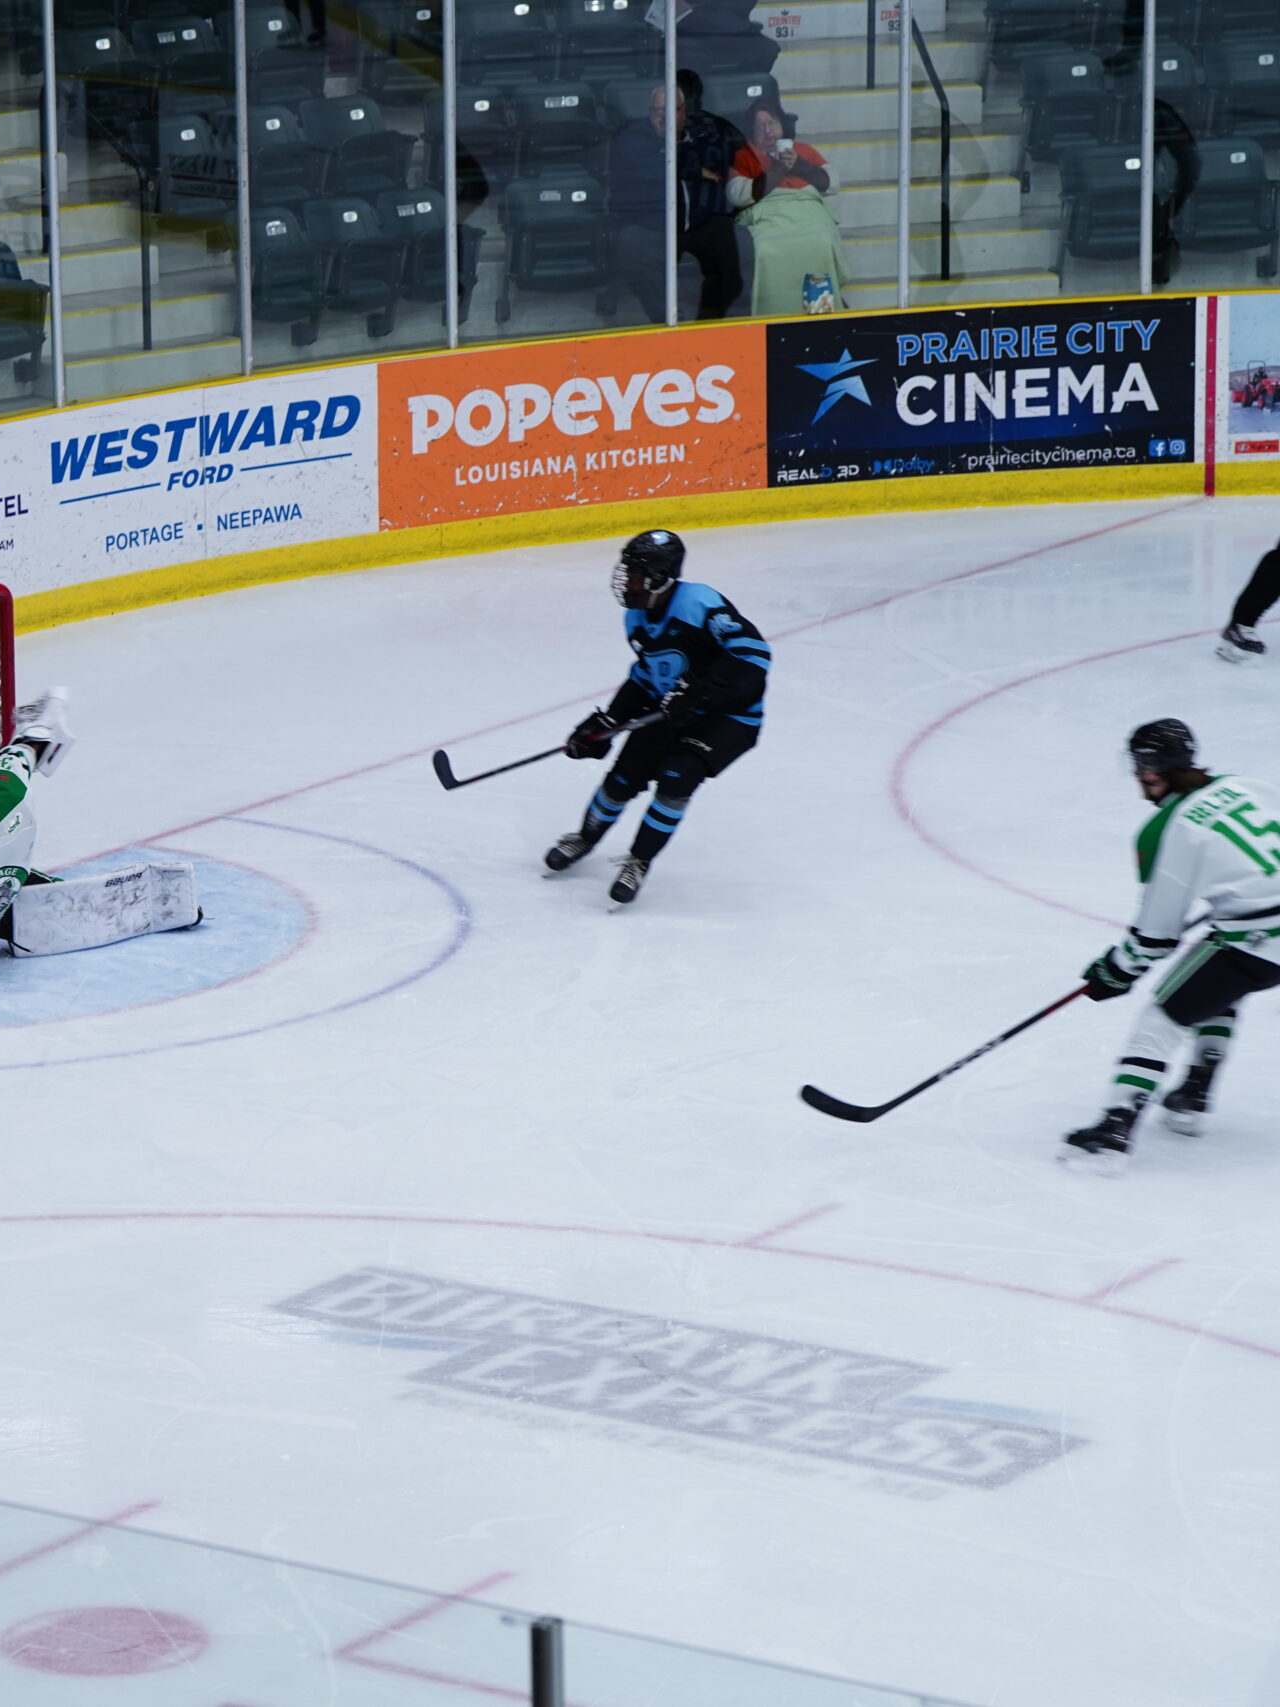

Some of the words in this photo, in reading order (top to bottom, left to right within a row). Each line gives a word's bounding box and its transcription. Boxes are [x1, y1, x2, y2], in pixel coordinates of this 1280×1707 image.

[768, 16, 802, 28] COUNTRY
[896, 324, 1058, 367] PRAIRIE
[1066, 319, 1161, 355] CITY
[895, 362, 1159, 427] CINEMA
[50, 394, 361, 485] WESTWARD
[967, 446, 1136, 471] prairiecitycinema.ca
[166, 463, 234, 492] FORD
[455, 454, 577, 487] LOUISIANA
[585, 444, 686, 471] KITCHEN
[893, 457, 934, 474] Dolby
[106, 521, 184, 553] PORTAGE
[217, 502, 303, 532] NEEPAWA
[105, 872, 143, 888] BAUER
[310, 1275, 895, 1405] BURBANK
[455, 1344, 1053, 1484] EXPRESS
